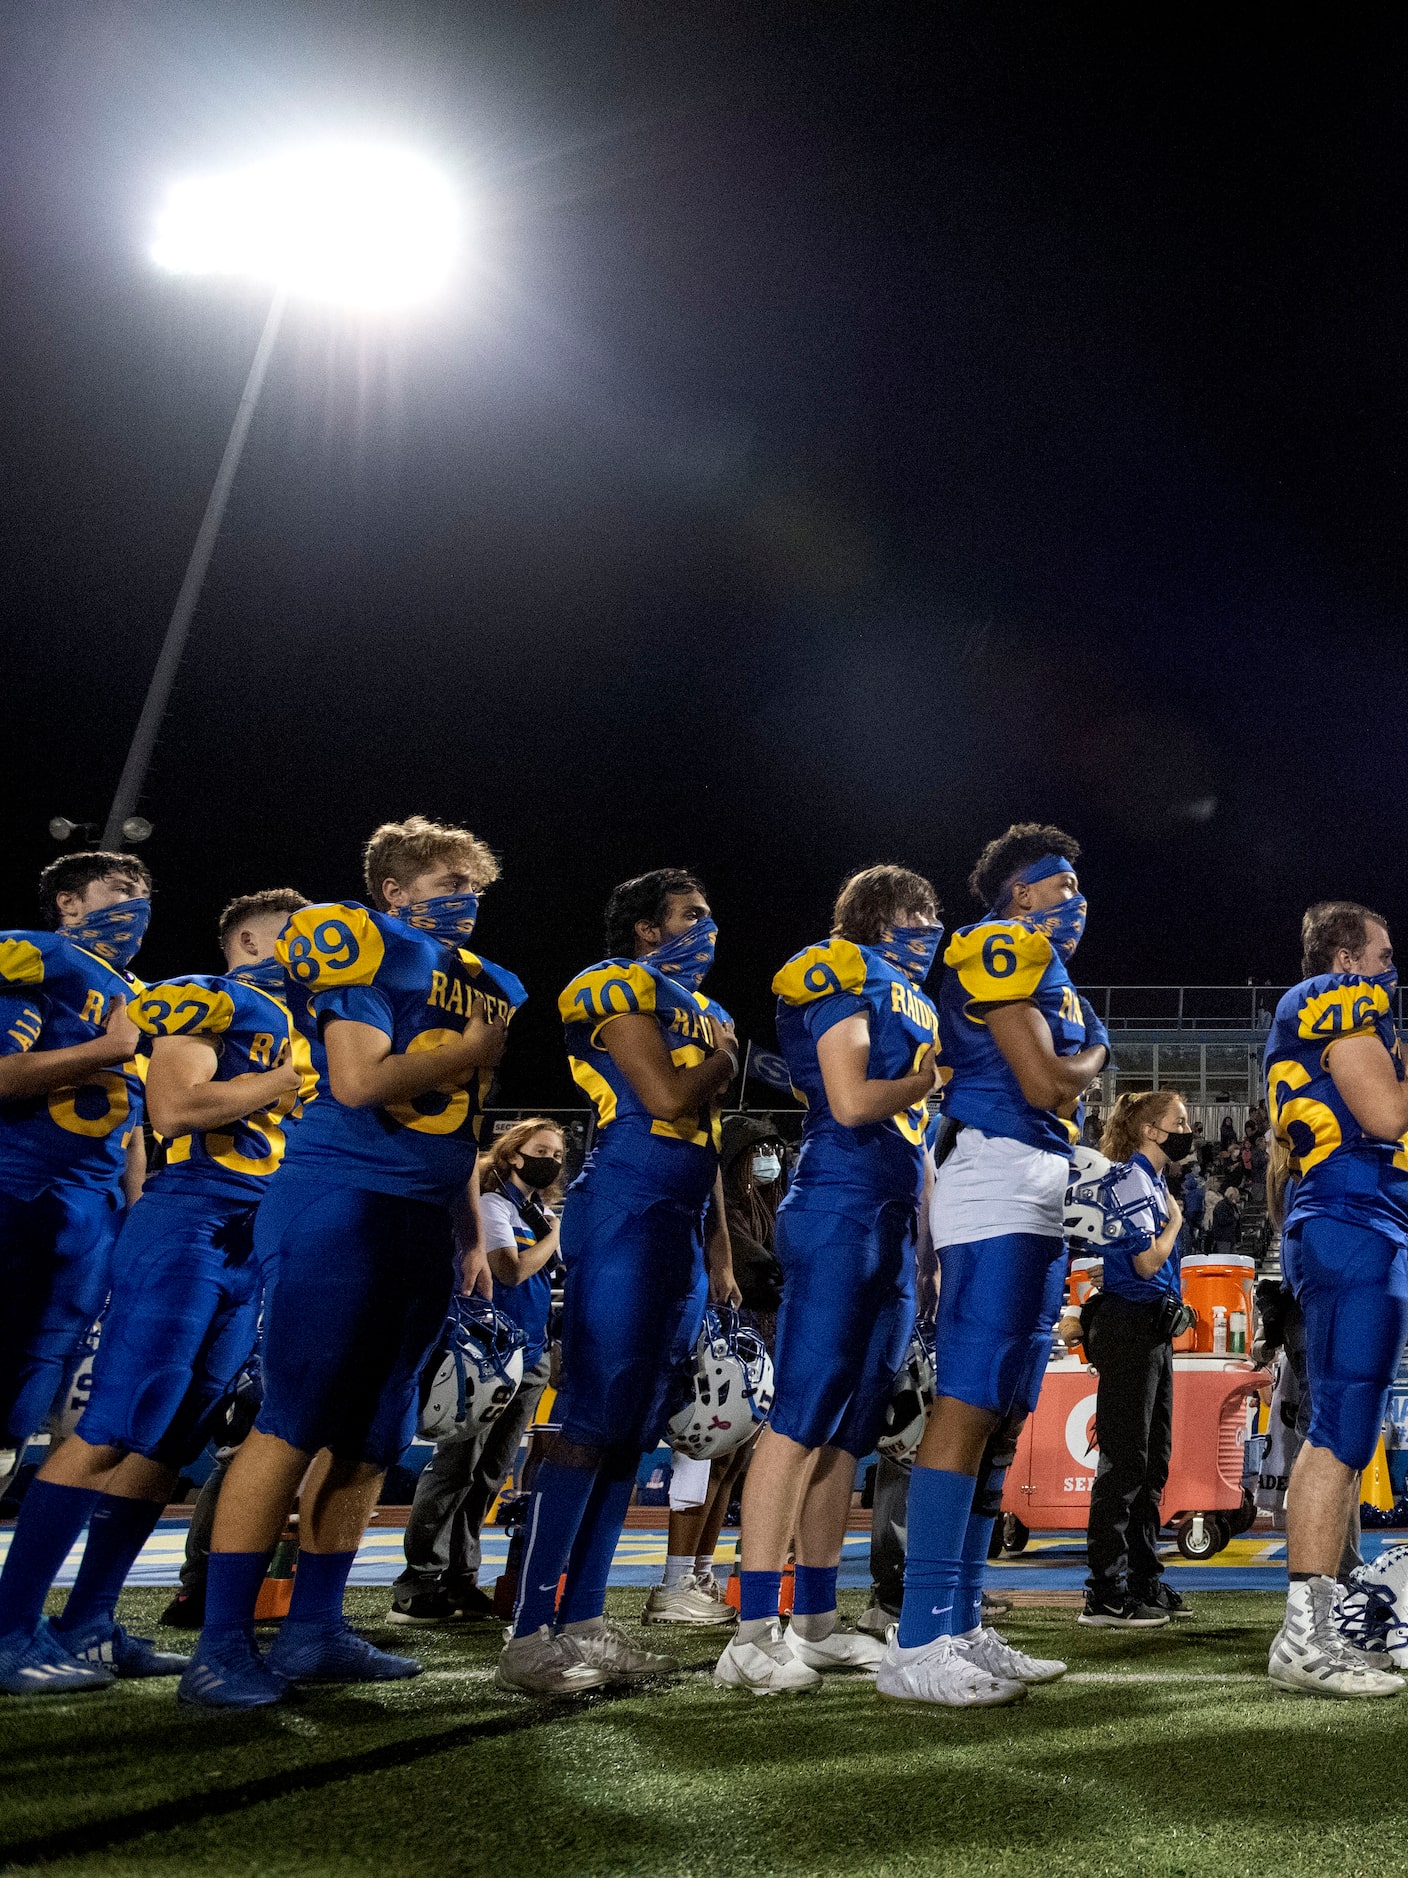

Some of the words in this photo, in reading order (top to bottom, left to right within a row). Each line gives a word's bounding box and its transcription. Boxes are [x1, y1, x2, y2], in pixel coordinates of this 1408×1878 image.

[289, 919, 360, 983] 89
[982, 933, 1018, 979] 6
[804, 962, 843, 993] 9
[140, 1000, 211, 1036] 32
[574, 978, 641, 1019] 10
[1311, 995, 1380, 1036] 46
